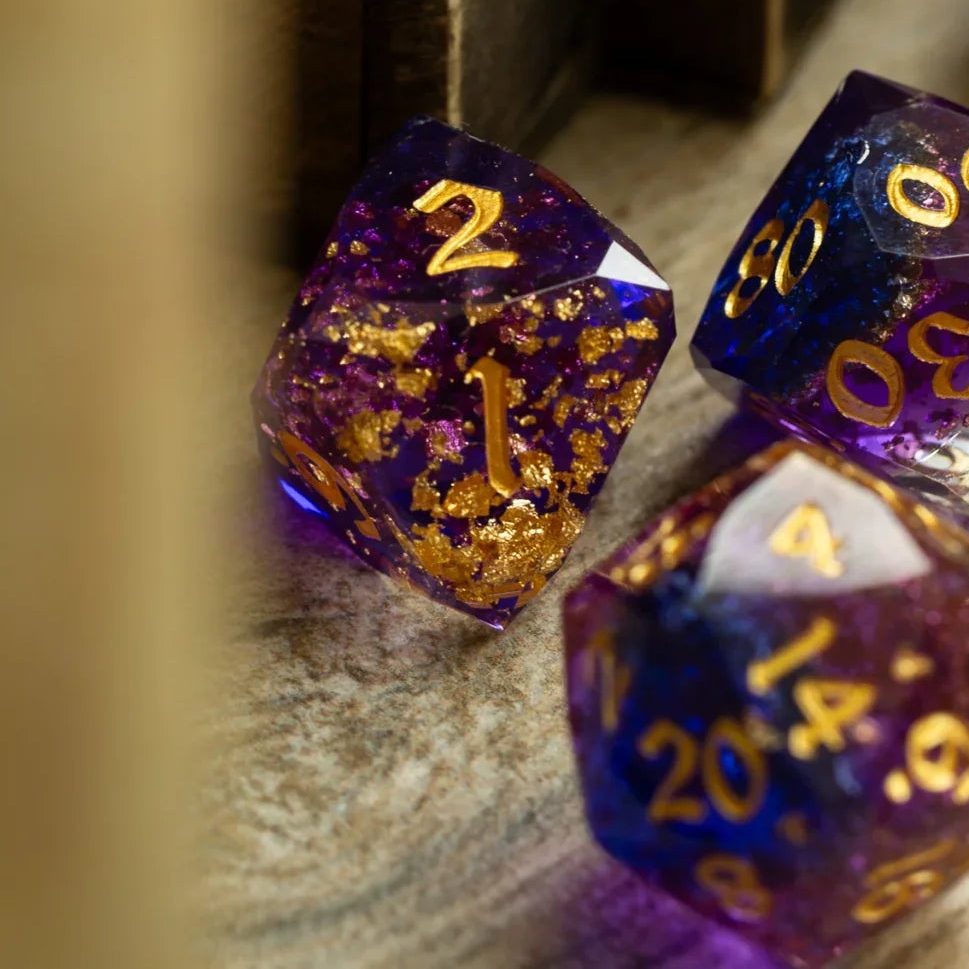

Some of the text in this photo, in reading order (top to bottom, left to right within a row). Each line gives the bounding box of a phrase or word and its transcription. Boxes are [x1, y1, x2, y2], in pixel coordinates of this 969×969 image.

[413, 179, 519, 277] 2
[724, 199, 829, 319] 80
[465, 358, 523, 498] 1
[767, 503, 845, 579] 4
[638, 718, 767, 823] 20
